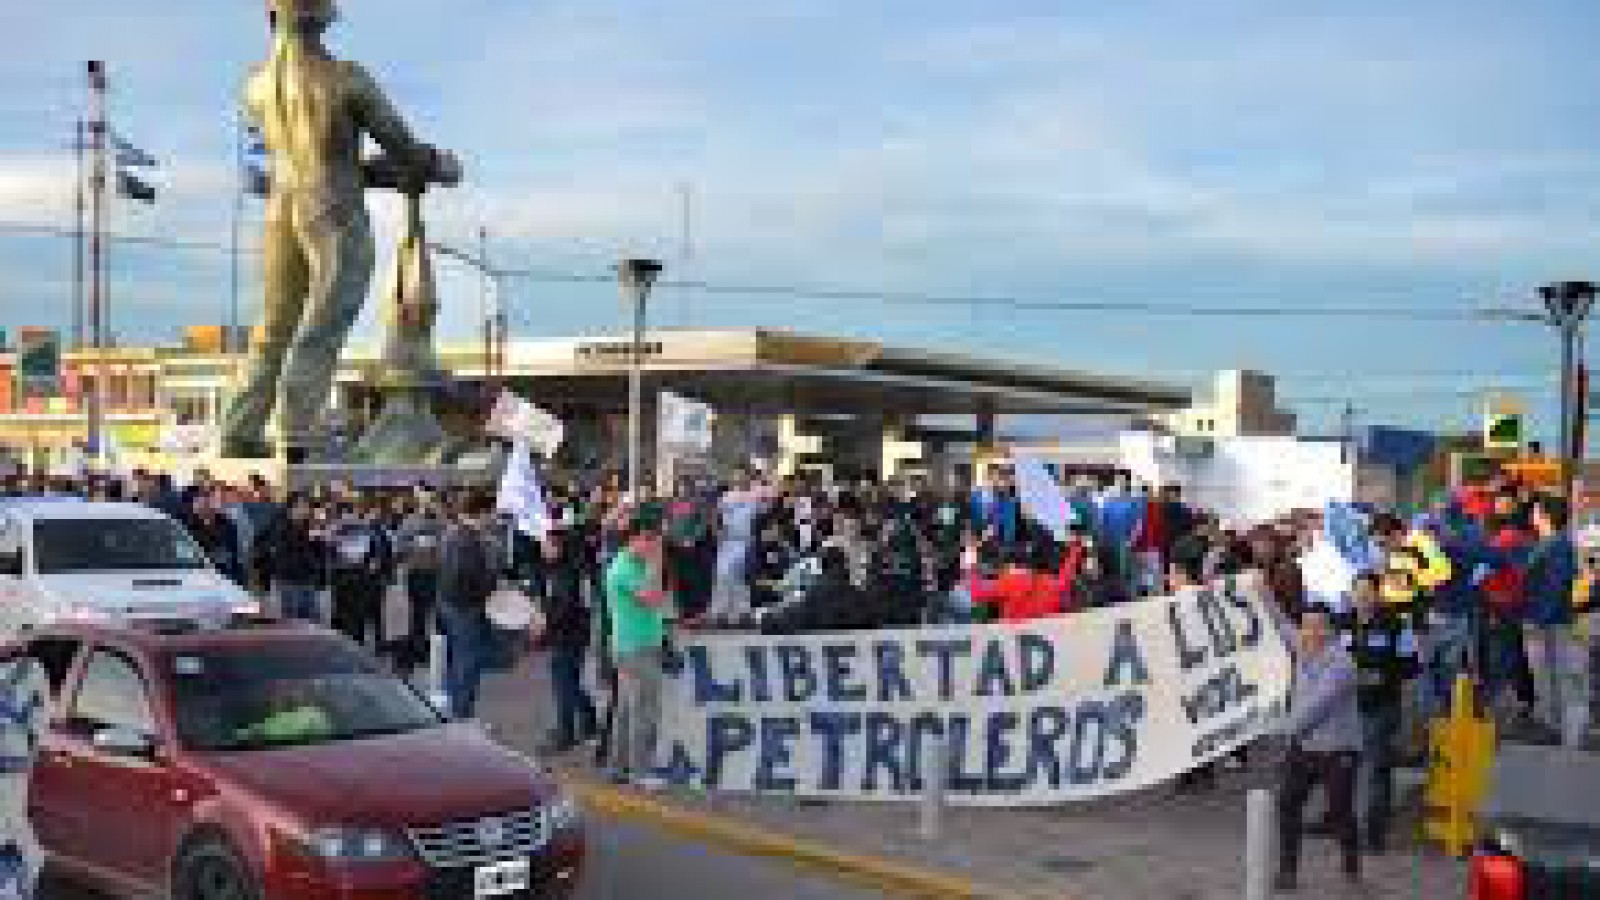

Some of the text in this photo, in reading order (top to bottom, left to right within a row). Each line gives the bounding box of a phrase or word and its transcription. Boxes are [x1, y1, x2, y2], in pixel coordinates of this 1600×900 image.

[689, 587, 1260, 706] LIBERTAD A LOS
